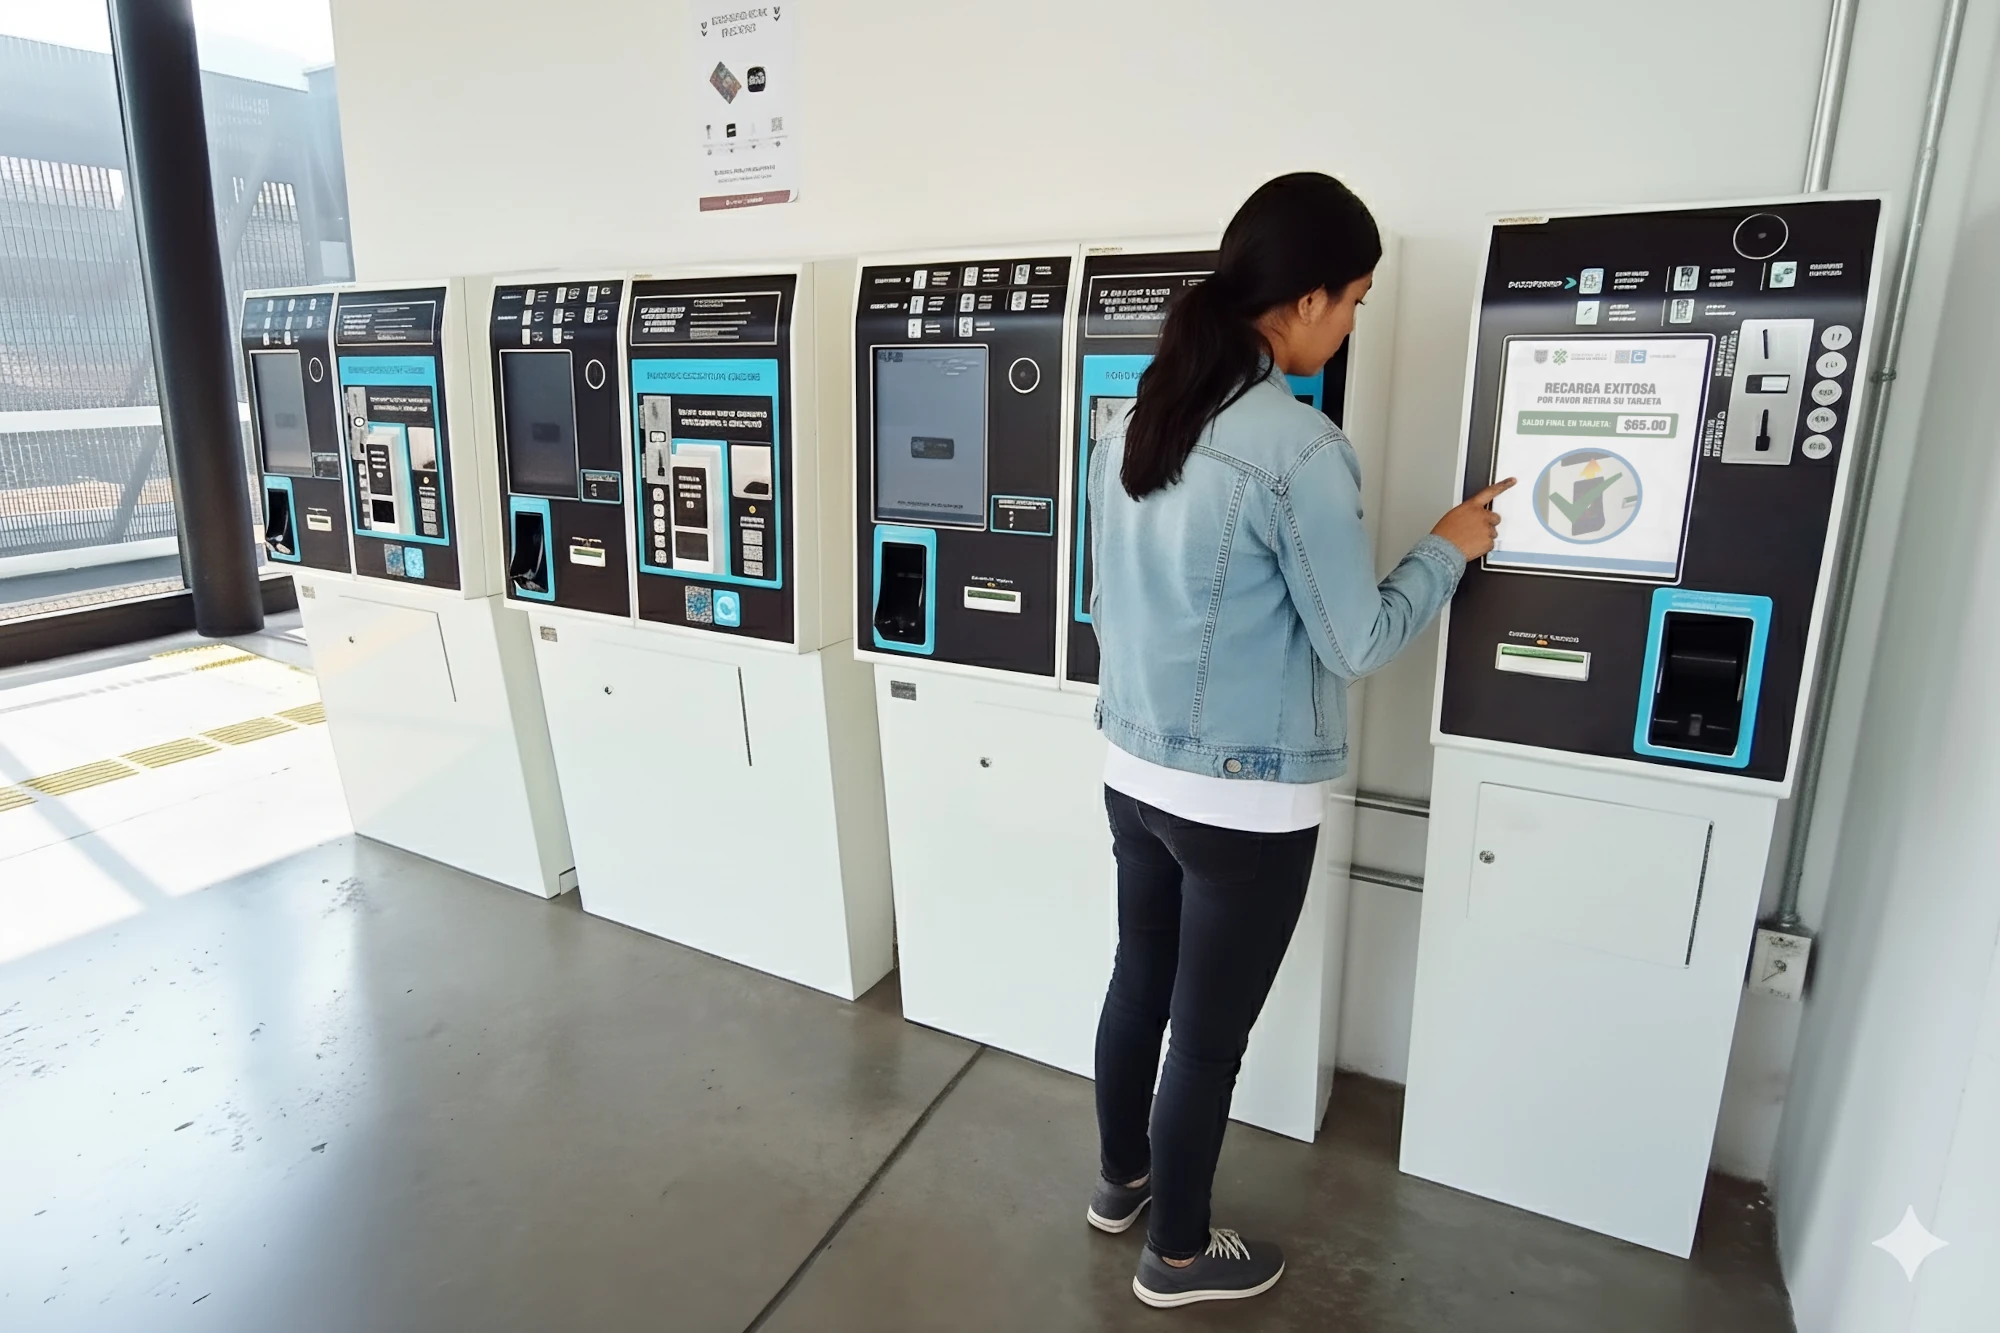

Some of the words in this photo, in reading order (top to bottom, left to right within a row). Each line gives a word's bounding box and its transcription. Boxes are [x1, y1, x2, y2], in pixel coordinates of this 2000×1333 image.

[1544, 382, 1600, 394] RECARGA
[1604, 382, 1656, 395] EXITOSA
[1537, 396, 1553, 404] POR
[1555, 396, 1581, 404] FAVOR
[1582, 396, 1611, 405] RETIRA
[1613, 397, 1624, 405] SU
[1627, 397, 1662, 405] TARJETA
[1522, 418, 1545, 427] SALDO
[1545, 419, 1566, 427] FINAL
[1567, 419, 1577, 427] EN
[1578, 420, 1612, 428] TARJETA:
[1623, 419, 1667, 432] $65.00
